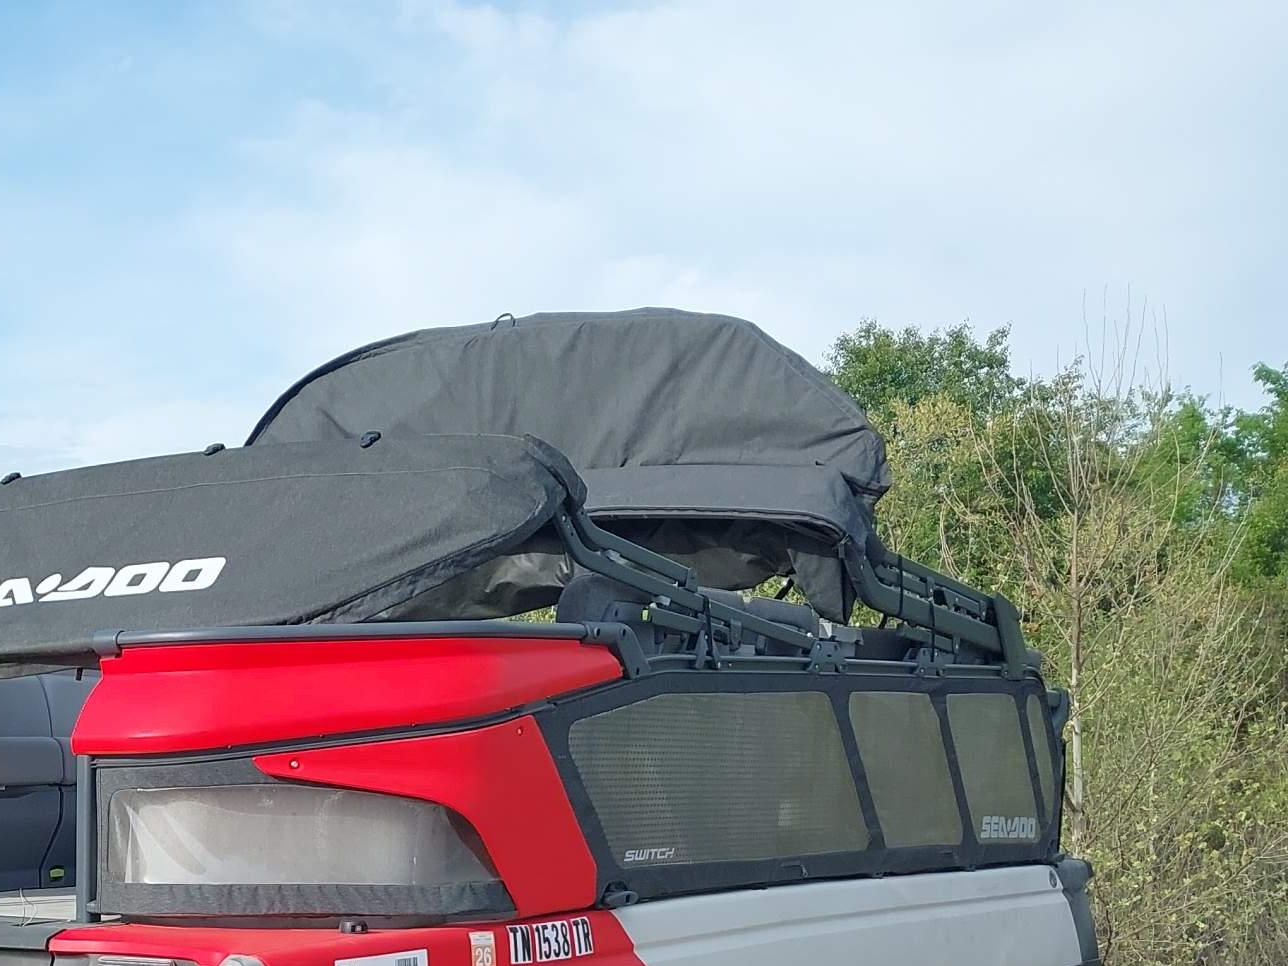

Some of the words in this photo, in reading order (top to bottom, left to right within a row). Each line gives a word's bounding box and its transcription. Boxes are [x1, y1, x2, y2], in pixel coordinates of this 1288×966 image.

[623, 847, 675, 861] SWITCH
[509, 925, 532, 963] TN
[534, 922, 570, 960] 1538
[572, 918, 592, 954] TR
[475, 947, 492, 966] 26
